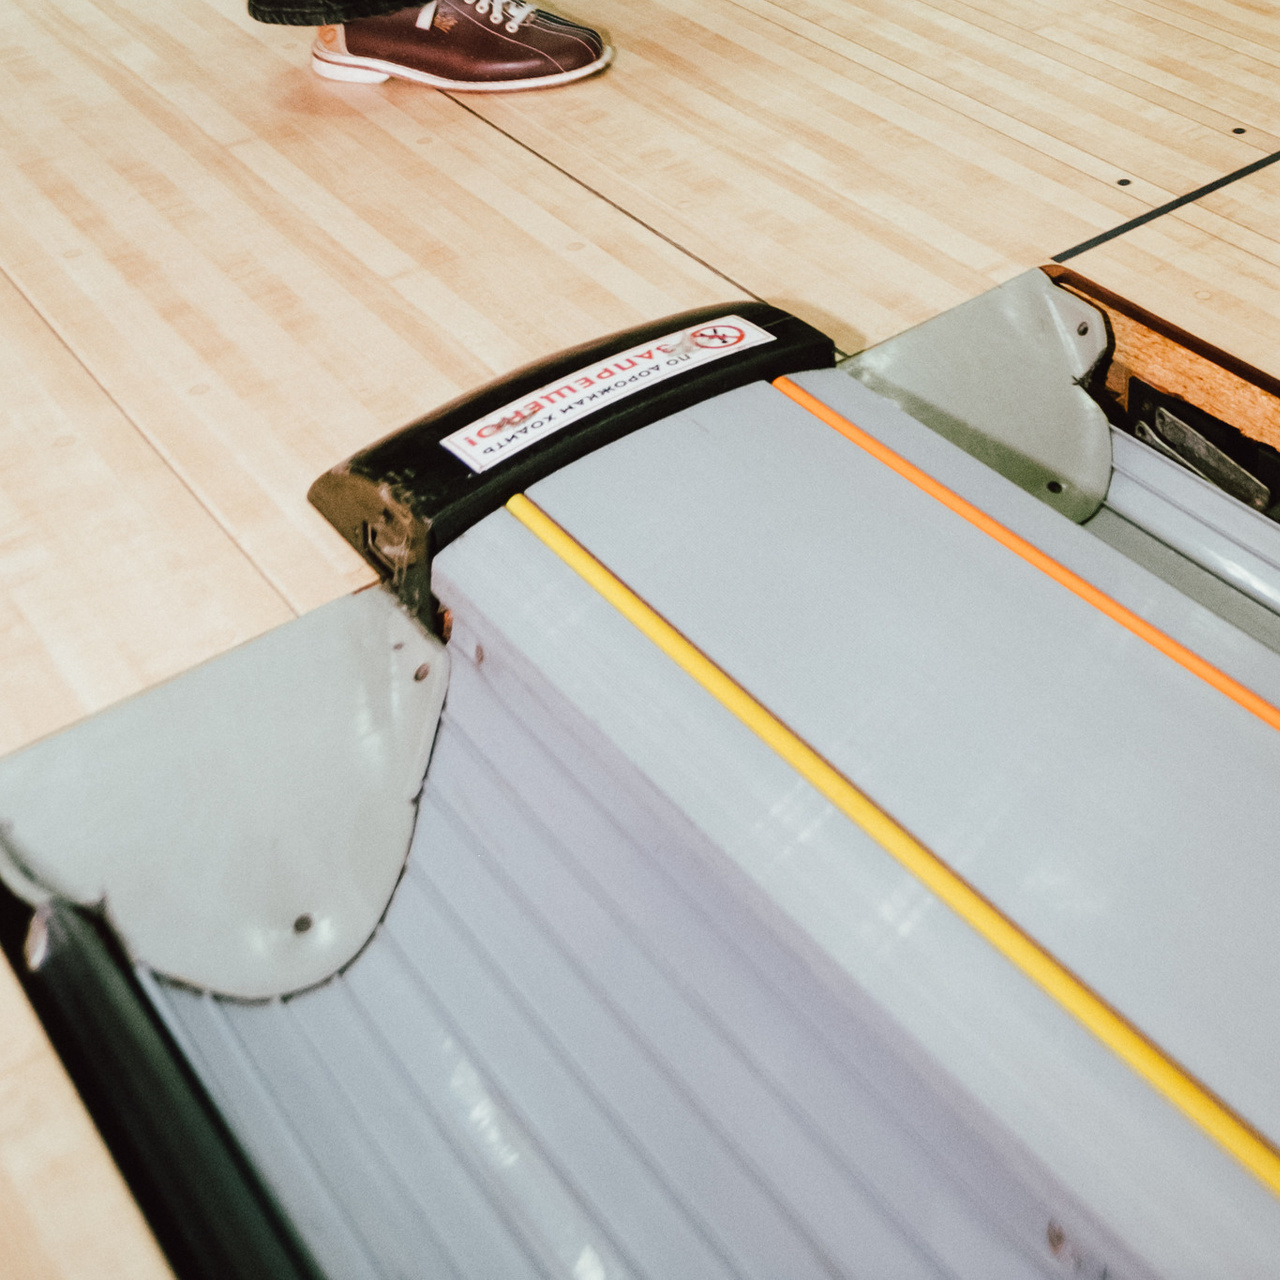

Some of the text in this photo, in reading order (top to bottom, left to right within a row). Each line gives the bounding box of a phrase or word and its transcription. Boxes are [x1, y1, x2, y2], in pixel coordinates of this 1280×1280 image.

[483, 353, 691, 455] ПО ДОРОЖКАМ ХОДИТЬ
